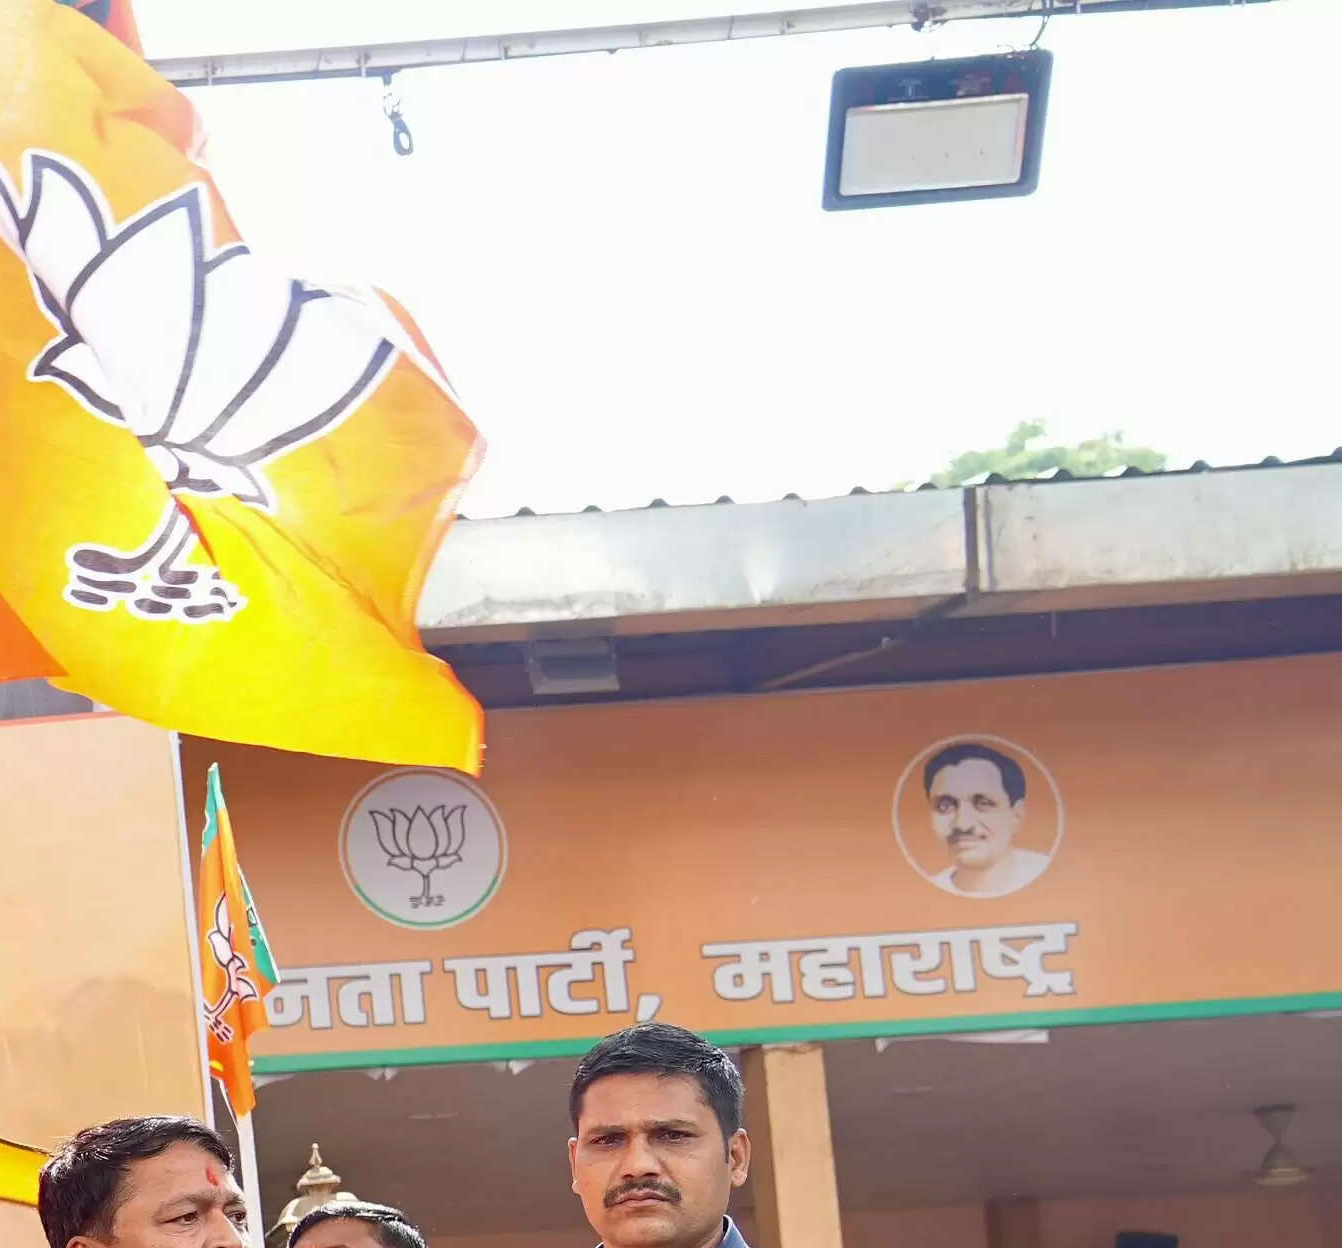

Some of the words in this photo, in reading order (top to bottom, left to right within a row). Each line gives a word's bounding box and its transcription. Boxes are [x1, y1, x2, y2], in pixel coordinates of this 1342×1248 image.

[263, 959, 433, 1031] नता
[443, 927, 662, 1024] पार्टी,
[700, 921, 1081, 1005] महाराष्ट्र
